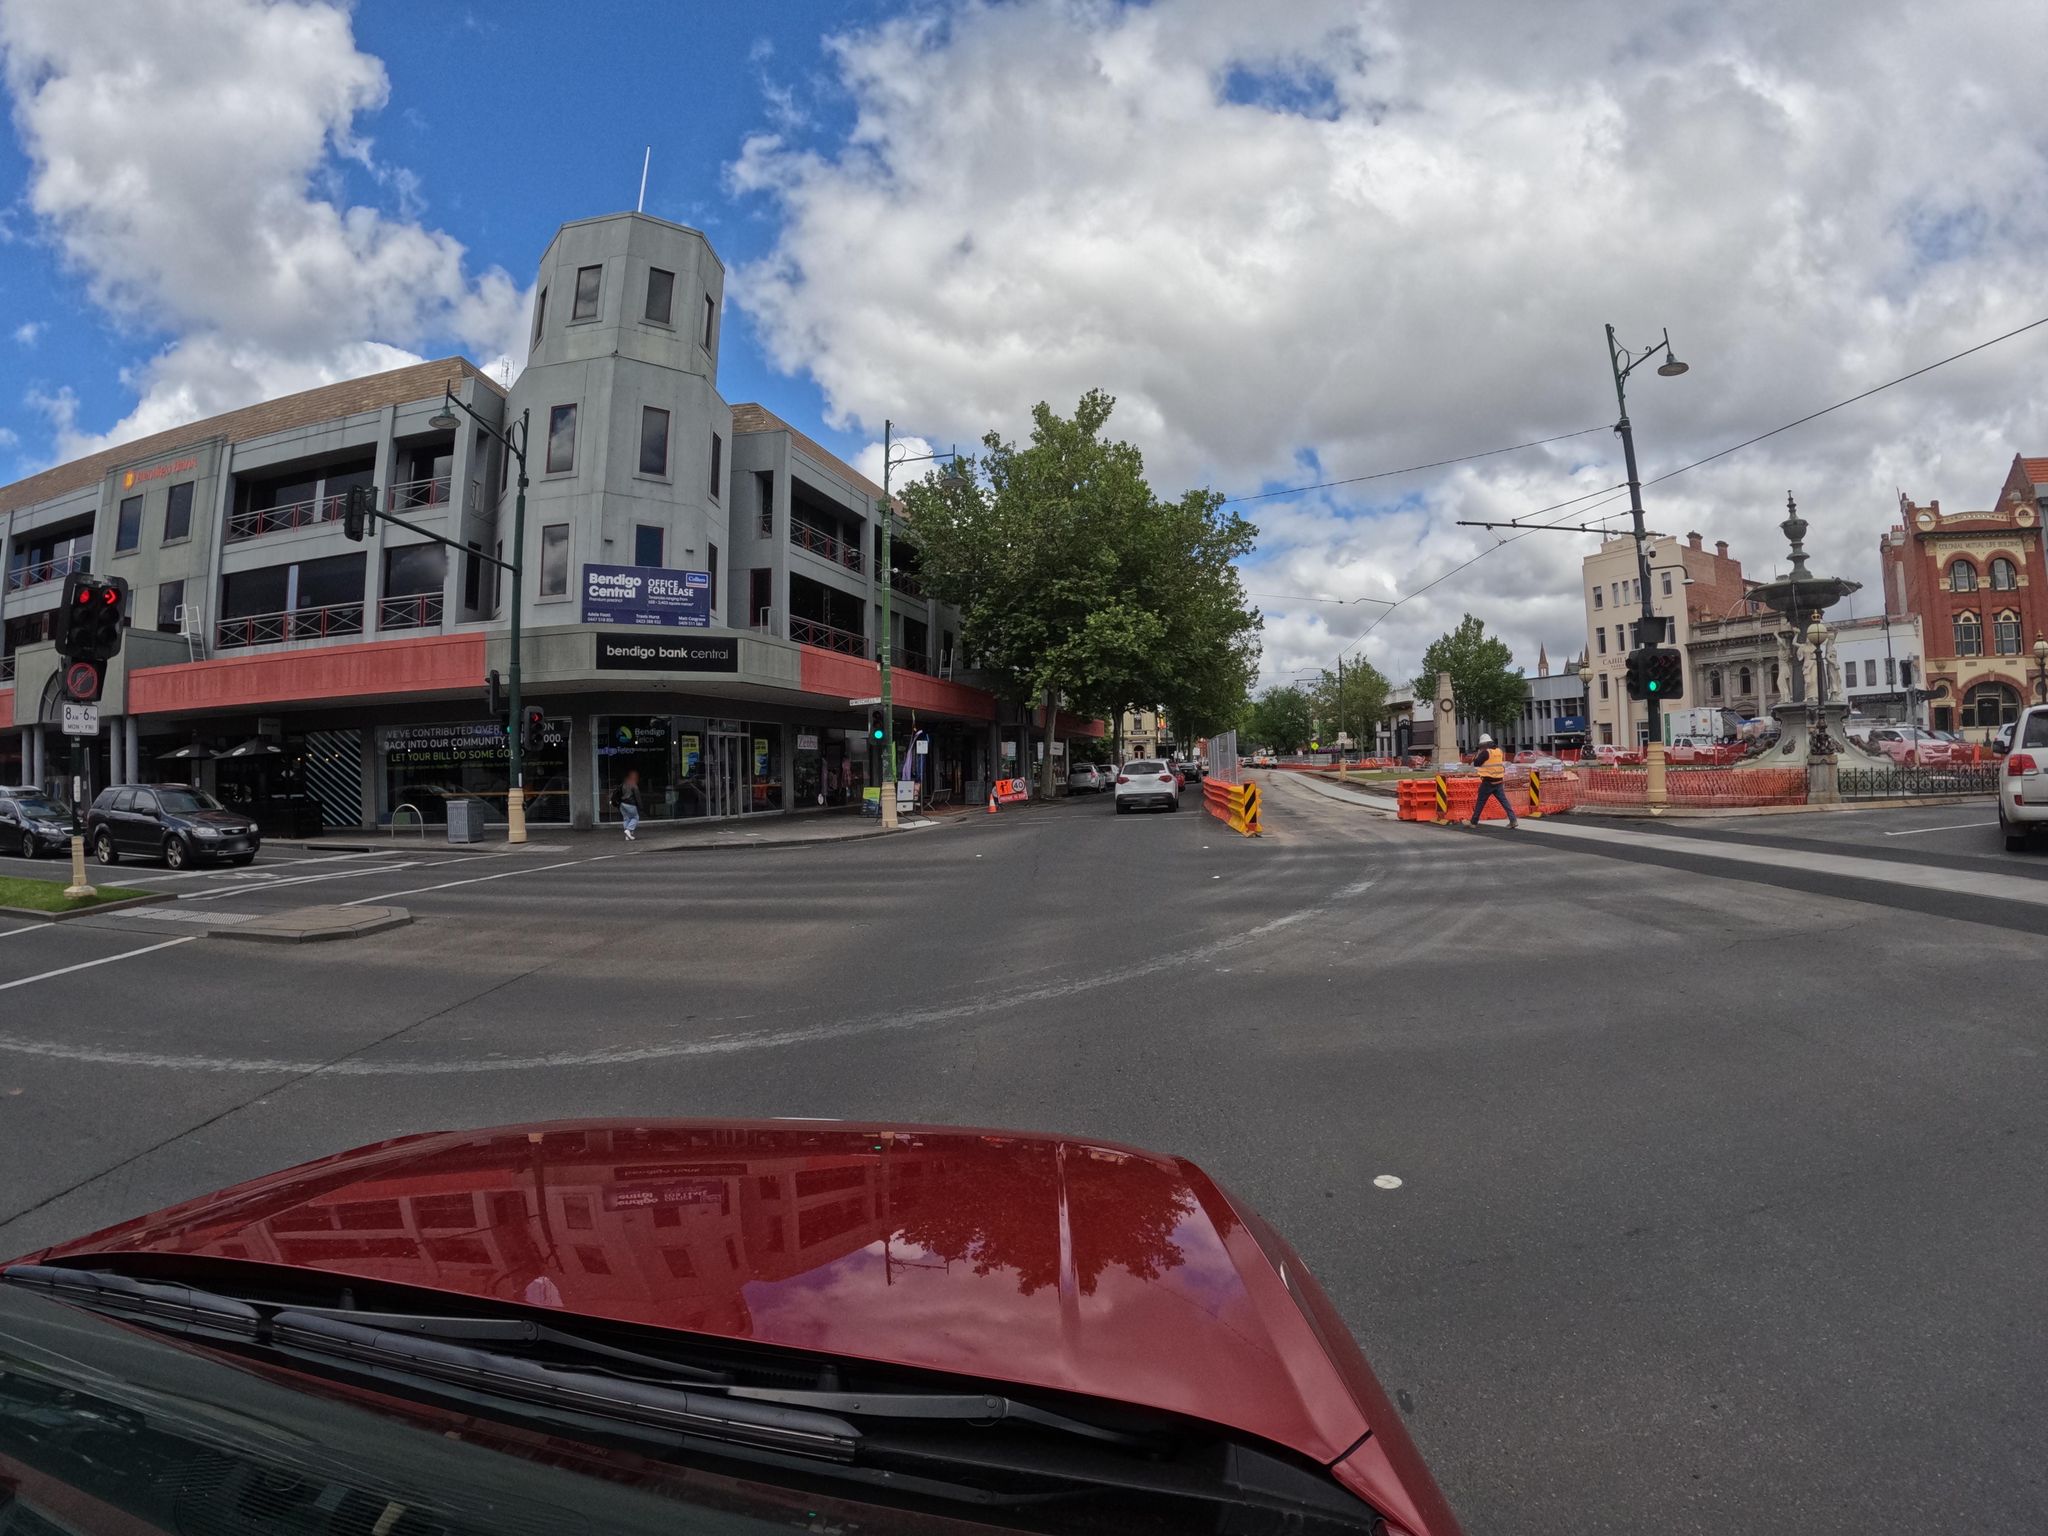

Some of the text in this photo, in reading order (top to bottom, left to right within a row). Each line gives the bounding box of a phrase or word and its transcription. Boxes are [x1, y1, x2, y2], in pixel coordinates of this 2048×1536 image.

[589, 573, 641, 588] Bendigo
[648, 579, 678, 588] OFFICE
[589, 586, 636, 598] Central
[668, 588, 694, 596] LEASE
[606, 645, 728, 659] bendigo bank central
[412, 727, 473, 737] CONTRIBUTED
[635, 728, 665, 736] Bendigo
[408, 740, 427, 748] INTO
[430, 739, 448, 747] OUR
[451, 736, 506, 747] COMMUNITY
[392, 749, 524, 762] LET YOUR BILL DO SOME GOD
